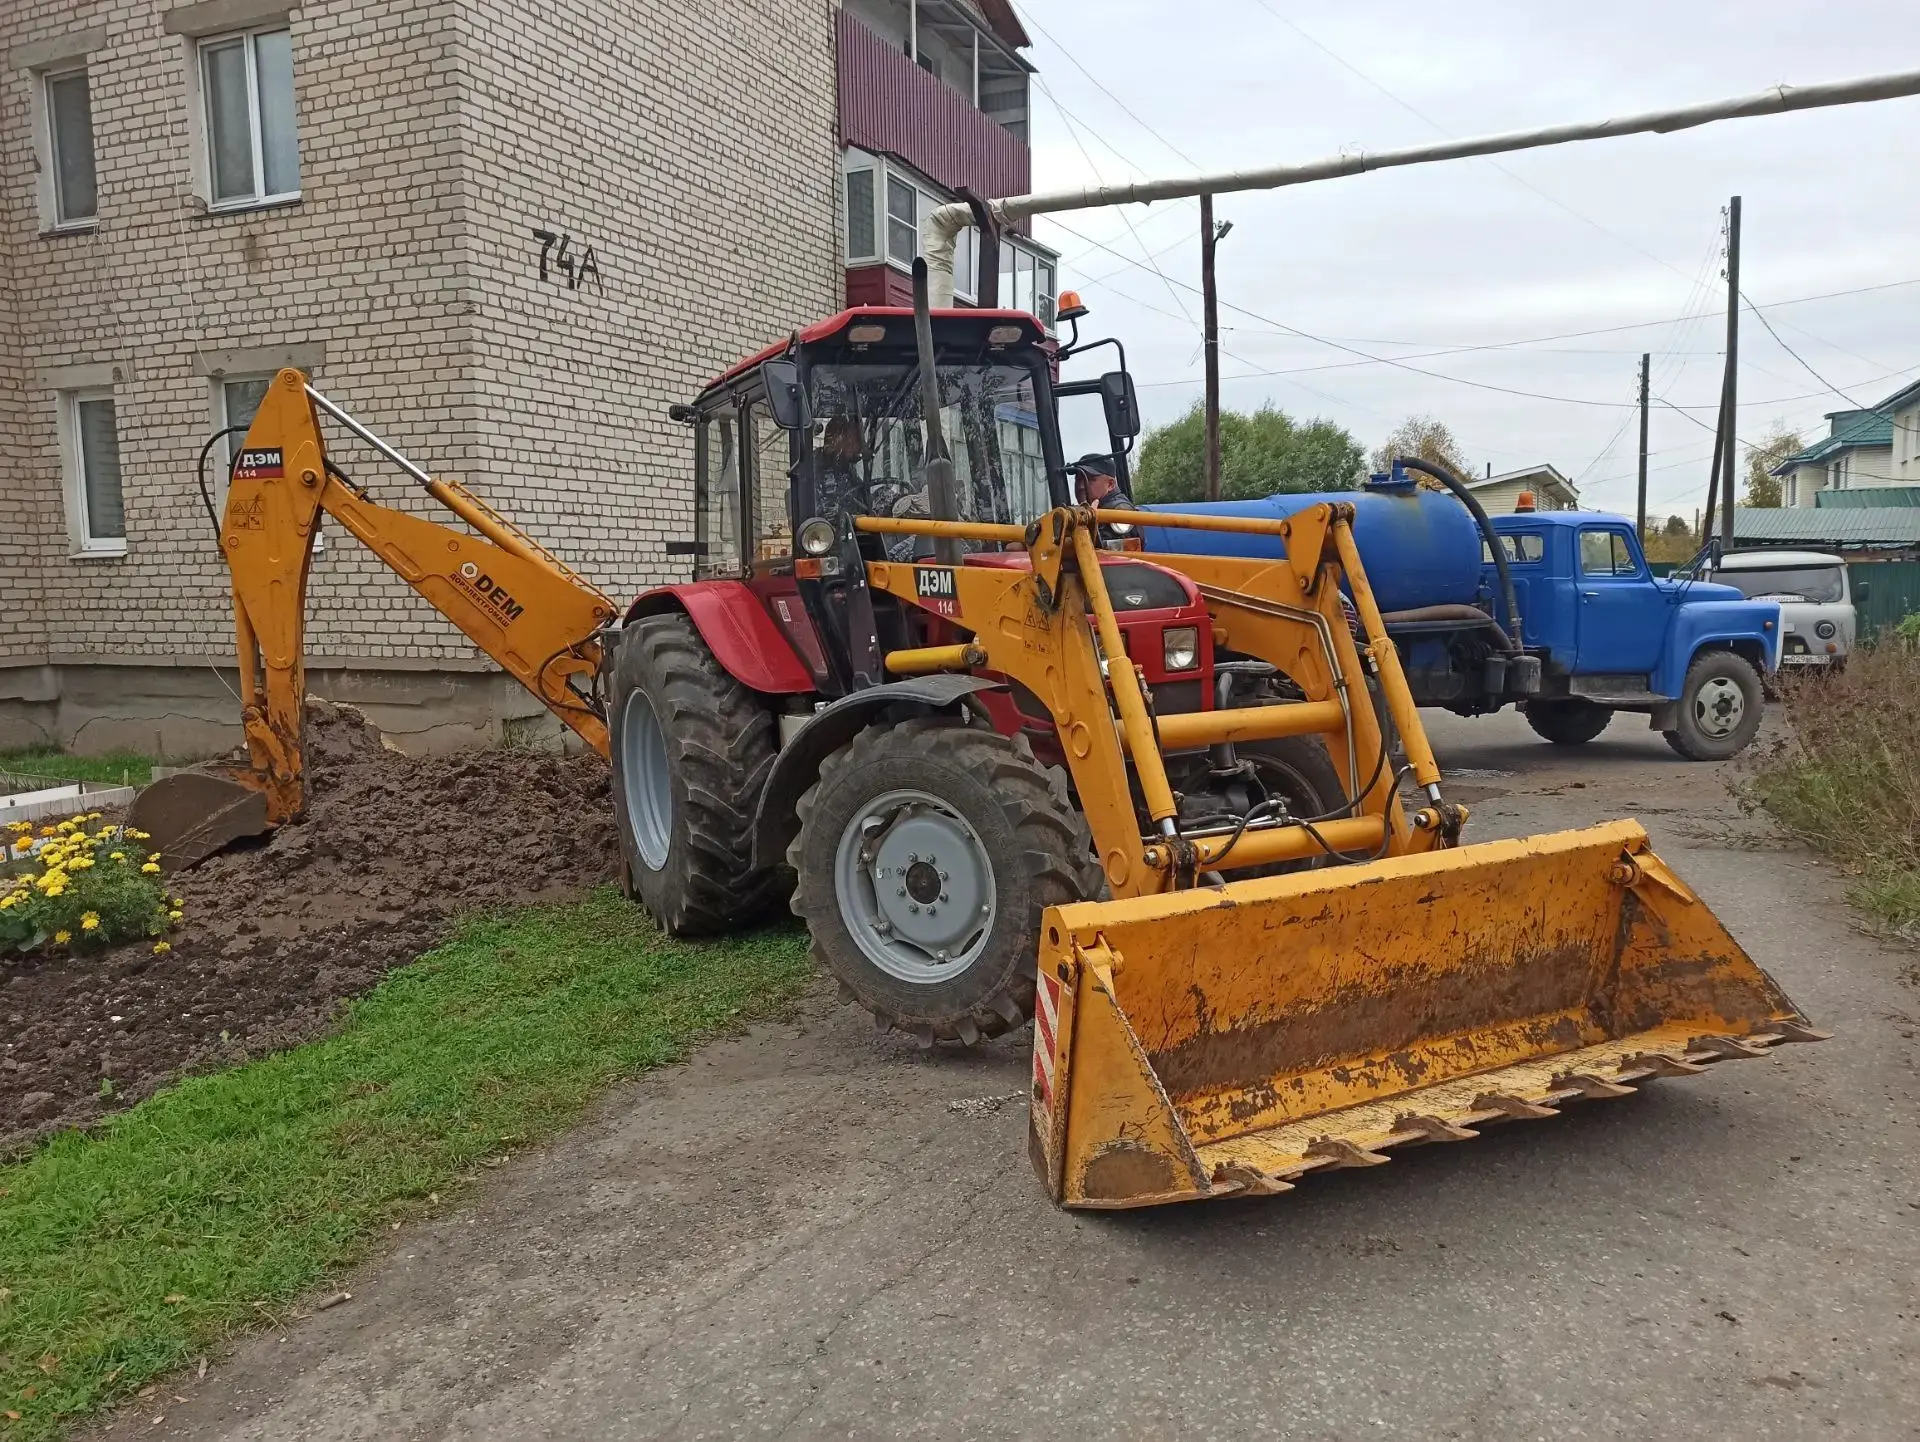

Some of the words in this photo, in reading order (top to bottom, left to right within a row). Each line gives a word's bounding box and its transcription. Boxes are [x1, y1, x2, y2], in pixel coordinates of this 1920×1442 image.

[243, 453, 280, 467] ДЭМ
[238, 470, 256, 478] 114
[919, 570, 952, 596] ДЭМ
[449, 573, 510, 628] ДОРЭЛЕКТРОМАШ
[474, 574, 524, 621] DEM
[938, 600, 953, 614] 114
